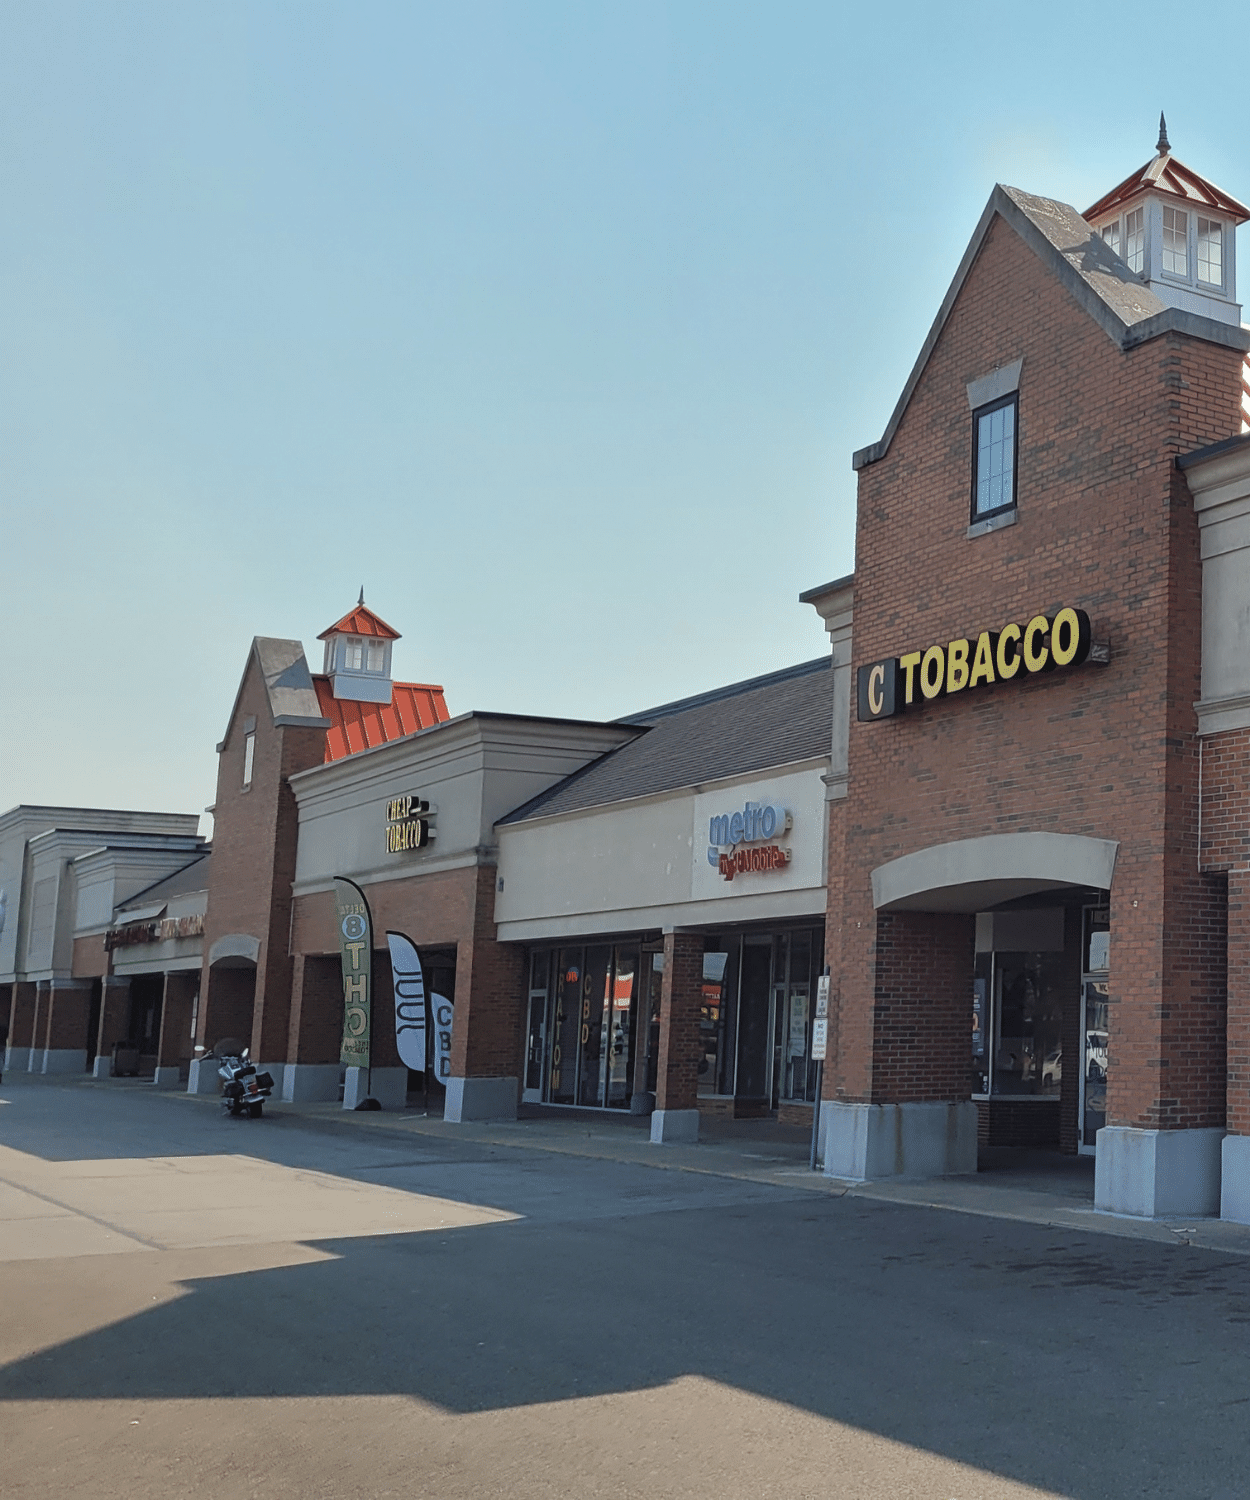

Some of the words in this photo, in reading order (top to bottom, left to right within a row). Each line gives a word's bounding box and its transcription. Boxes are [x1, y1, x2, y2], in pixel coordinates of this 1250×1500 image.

[868, 665, 884, 714] C
[901, 608, 1080, 704] TOBACCO
[385, 819, 421, 853] TOBACCO
[386, 796, 413, 821] CHEAP
[709, 802, 777, 846] metro
[393, 966, 425, 1035] JUUL
[437, 1005, 452, 1077] CBD
